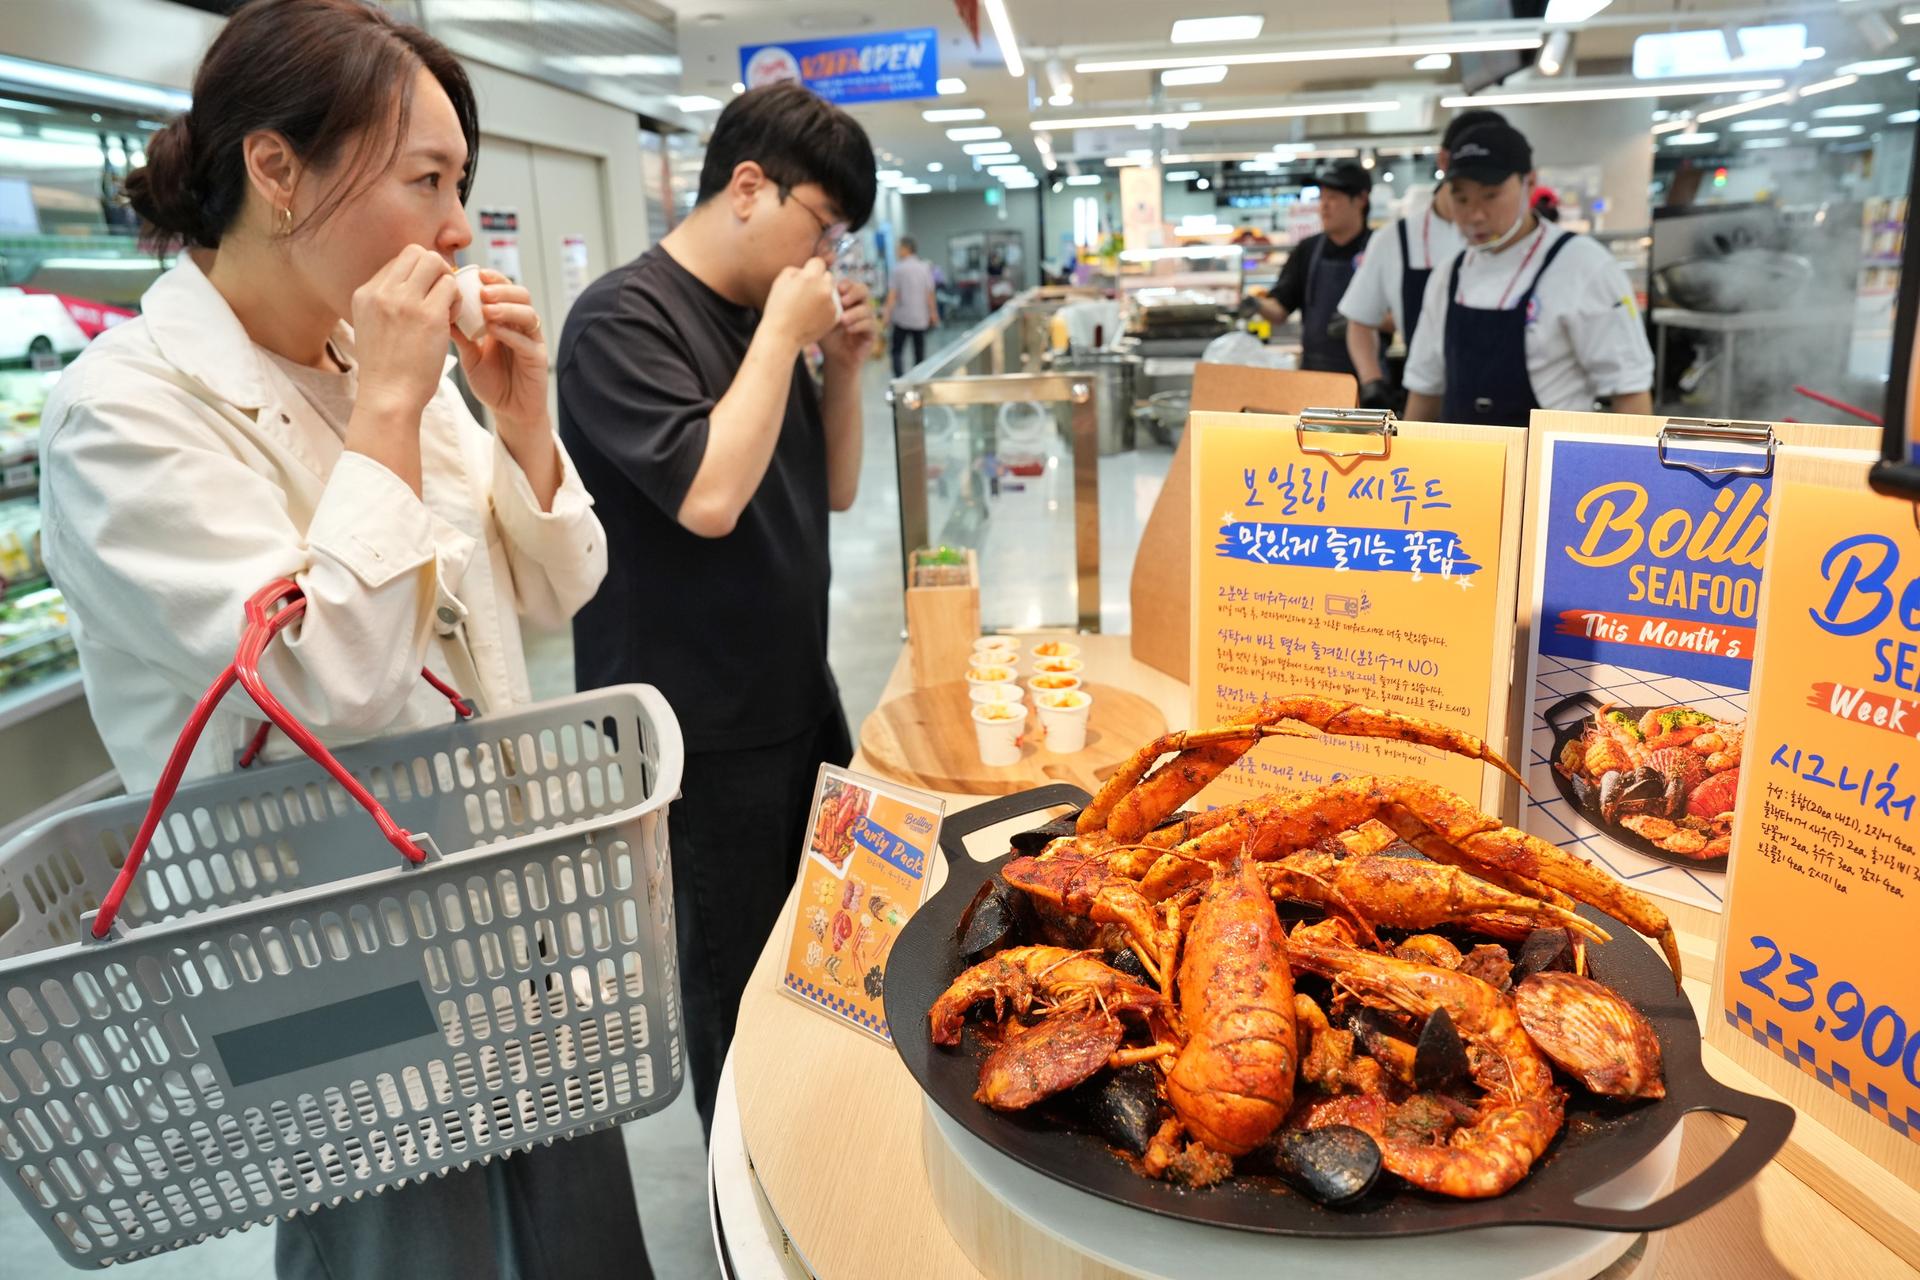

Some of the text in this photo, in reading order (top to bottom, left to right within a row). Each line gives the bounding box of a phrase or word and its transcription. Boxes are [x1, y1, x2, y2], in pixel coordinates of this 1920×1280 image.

[1244, 463, 1452, 525] 보일링 씨푸드
[1239, 523, 1455, 582] 맛있게 즐기는 꿀팁
[1564, 481, 1771, 570] Boili
[1218, 585, 1315, 611] 2분만 데워주세요!
[1628, 564, 1760, 619] SEAFOO
[1218, 628, 1252, 646] 식탁에
[1256, 635, 1275, 649] 바로
[1280, 637, 1306, 655] 펼쳐
[1403, 631, 1448, 647] 맛있습니다.
[1581, 613, 1742, 658] This Month's
[1873, 637, 1920, 693] SE
[1829, 683, 1920, 743] Week'
[1235, 756, 1256, 774] 용품
[1770, 744, 1917, 822] 시그니처
[1764, 800, 1808, 829] 블랙타이거
[1809, 824, 1845, 848] 새우(중)
[1871, 846, 1911, 875] 홍가리비
[1790, 789, 1832, 821] 홍합(20ea
[1864, 824, 1892, 843] 오징어
[855, 817, 890, 855] Party
[891, 841, 923, 875] Pack
[1757, 842, 1786, 864] 브로콜리
[1808, 867, 1833, 884] 소시지
[1812, 844, 1836, 868] 옥수수
[1859, 867, 1881, 884] 감자
